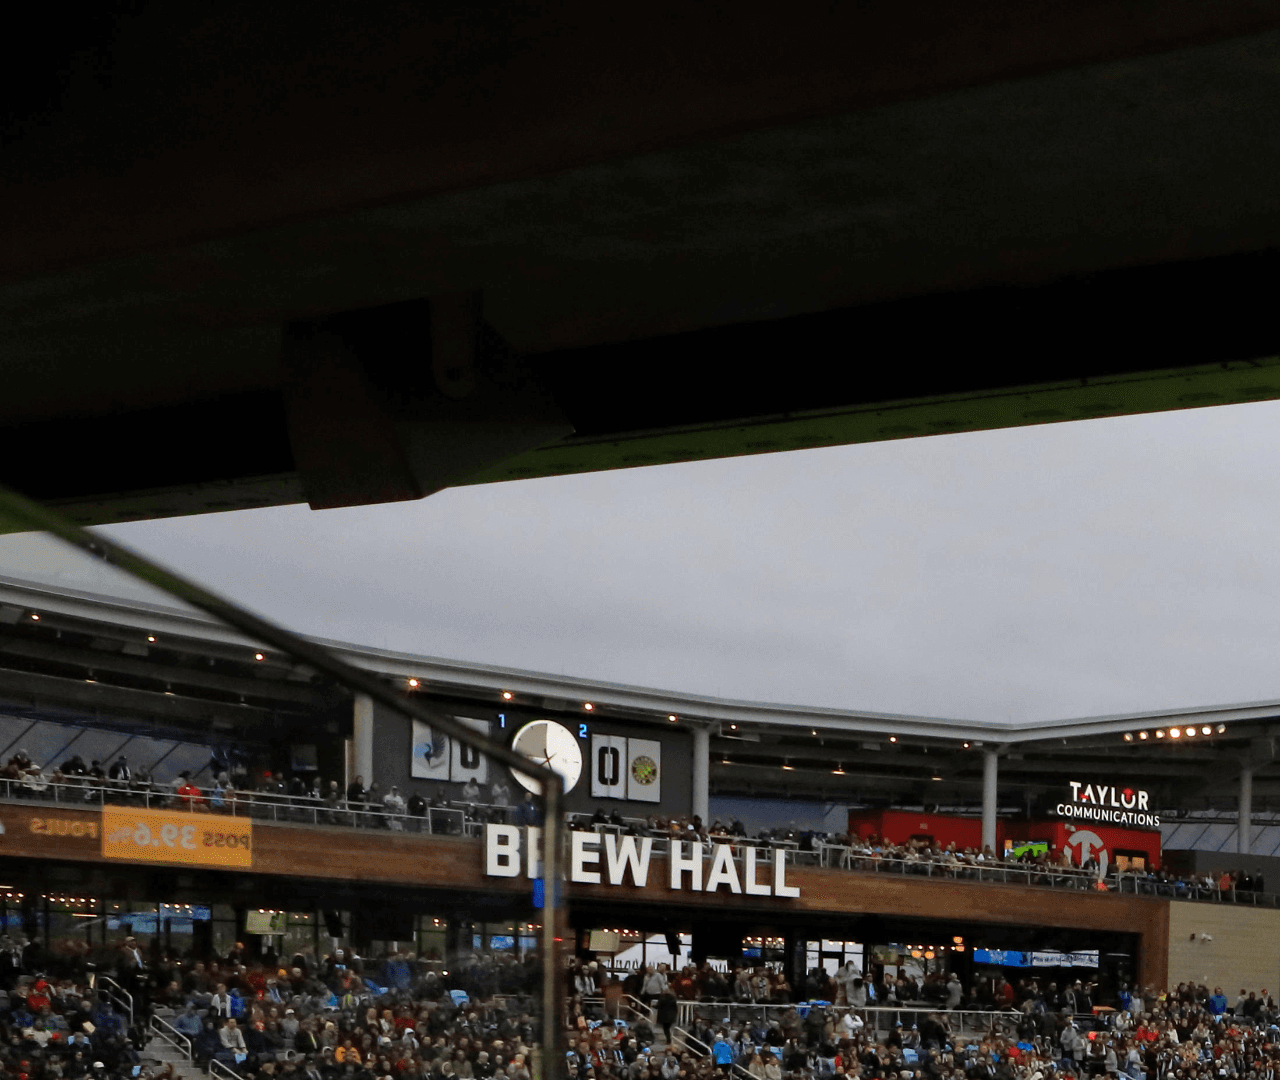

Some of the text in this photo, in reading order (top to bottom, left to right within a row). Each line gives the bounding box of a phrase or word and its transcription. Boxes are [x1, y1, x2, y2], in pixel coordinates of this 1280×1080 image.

[579, 724, 587, 738] 2
[598, 746, 619, 786] 0
[1069, 781, 1149, 811] TAYLOR
[1056, 803, 1160, 827] COMMUNICATIONS
[670, 839, 800, 898] HALL
